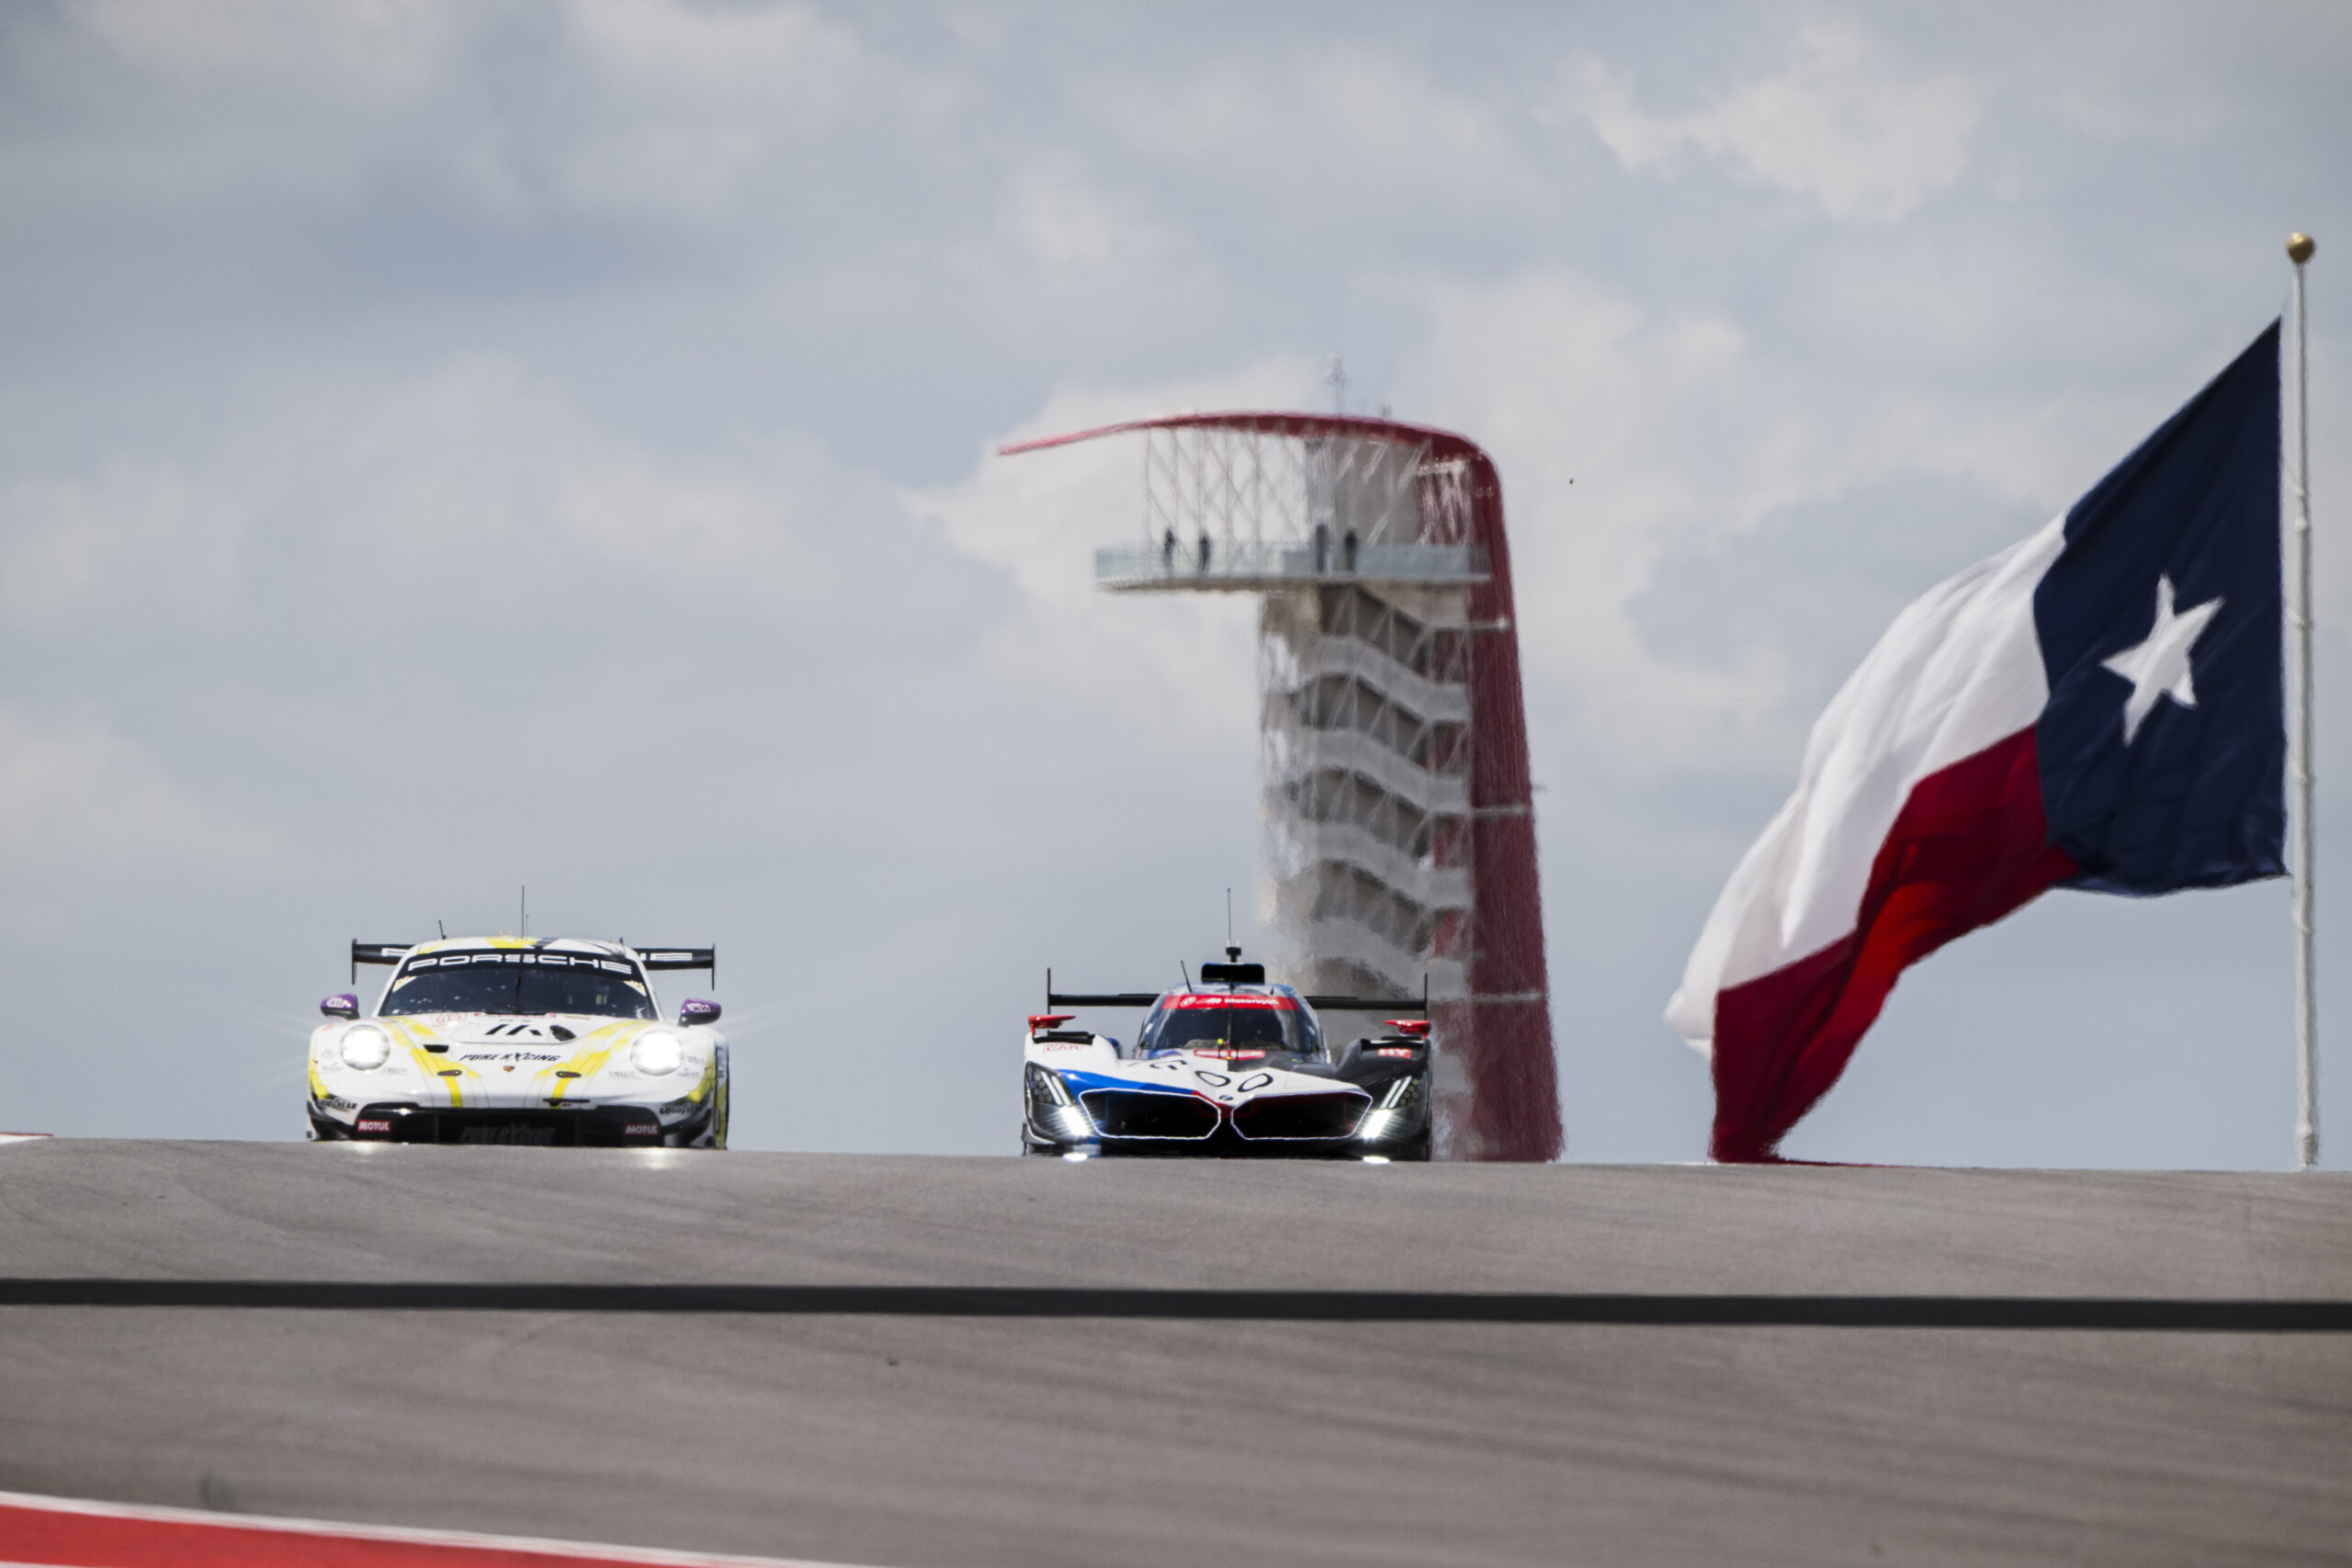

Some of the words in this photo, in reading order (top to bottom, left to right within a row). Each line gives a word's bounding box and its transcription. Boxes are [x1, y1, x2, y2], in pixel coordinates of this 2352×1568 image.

[407, 954, 632, 974] PORSCHE
[357, 1120, 390, 1131] MOTUL
[625, 1124, 658, 1134] MOTUL
